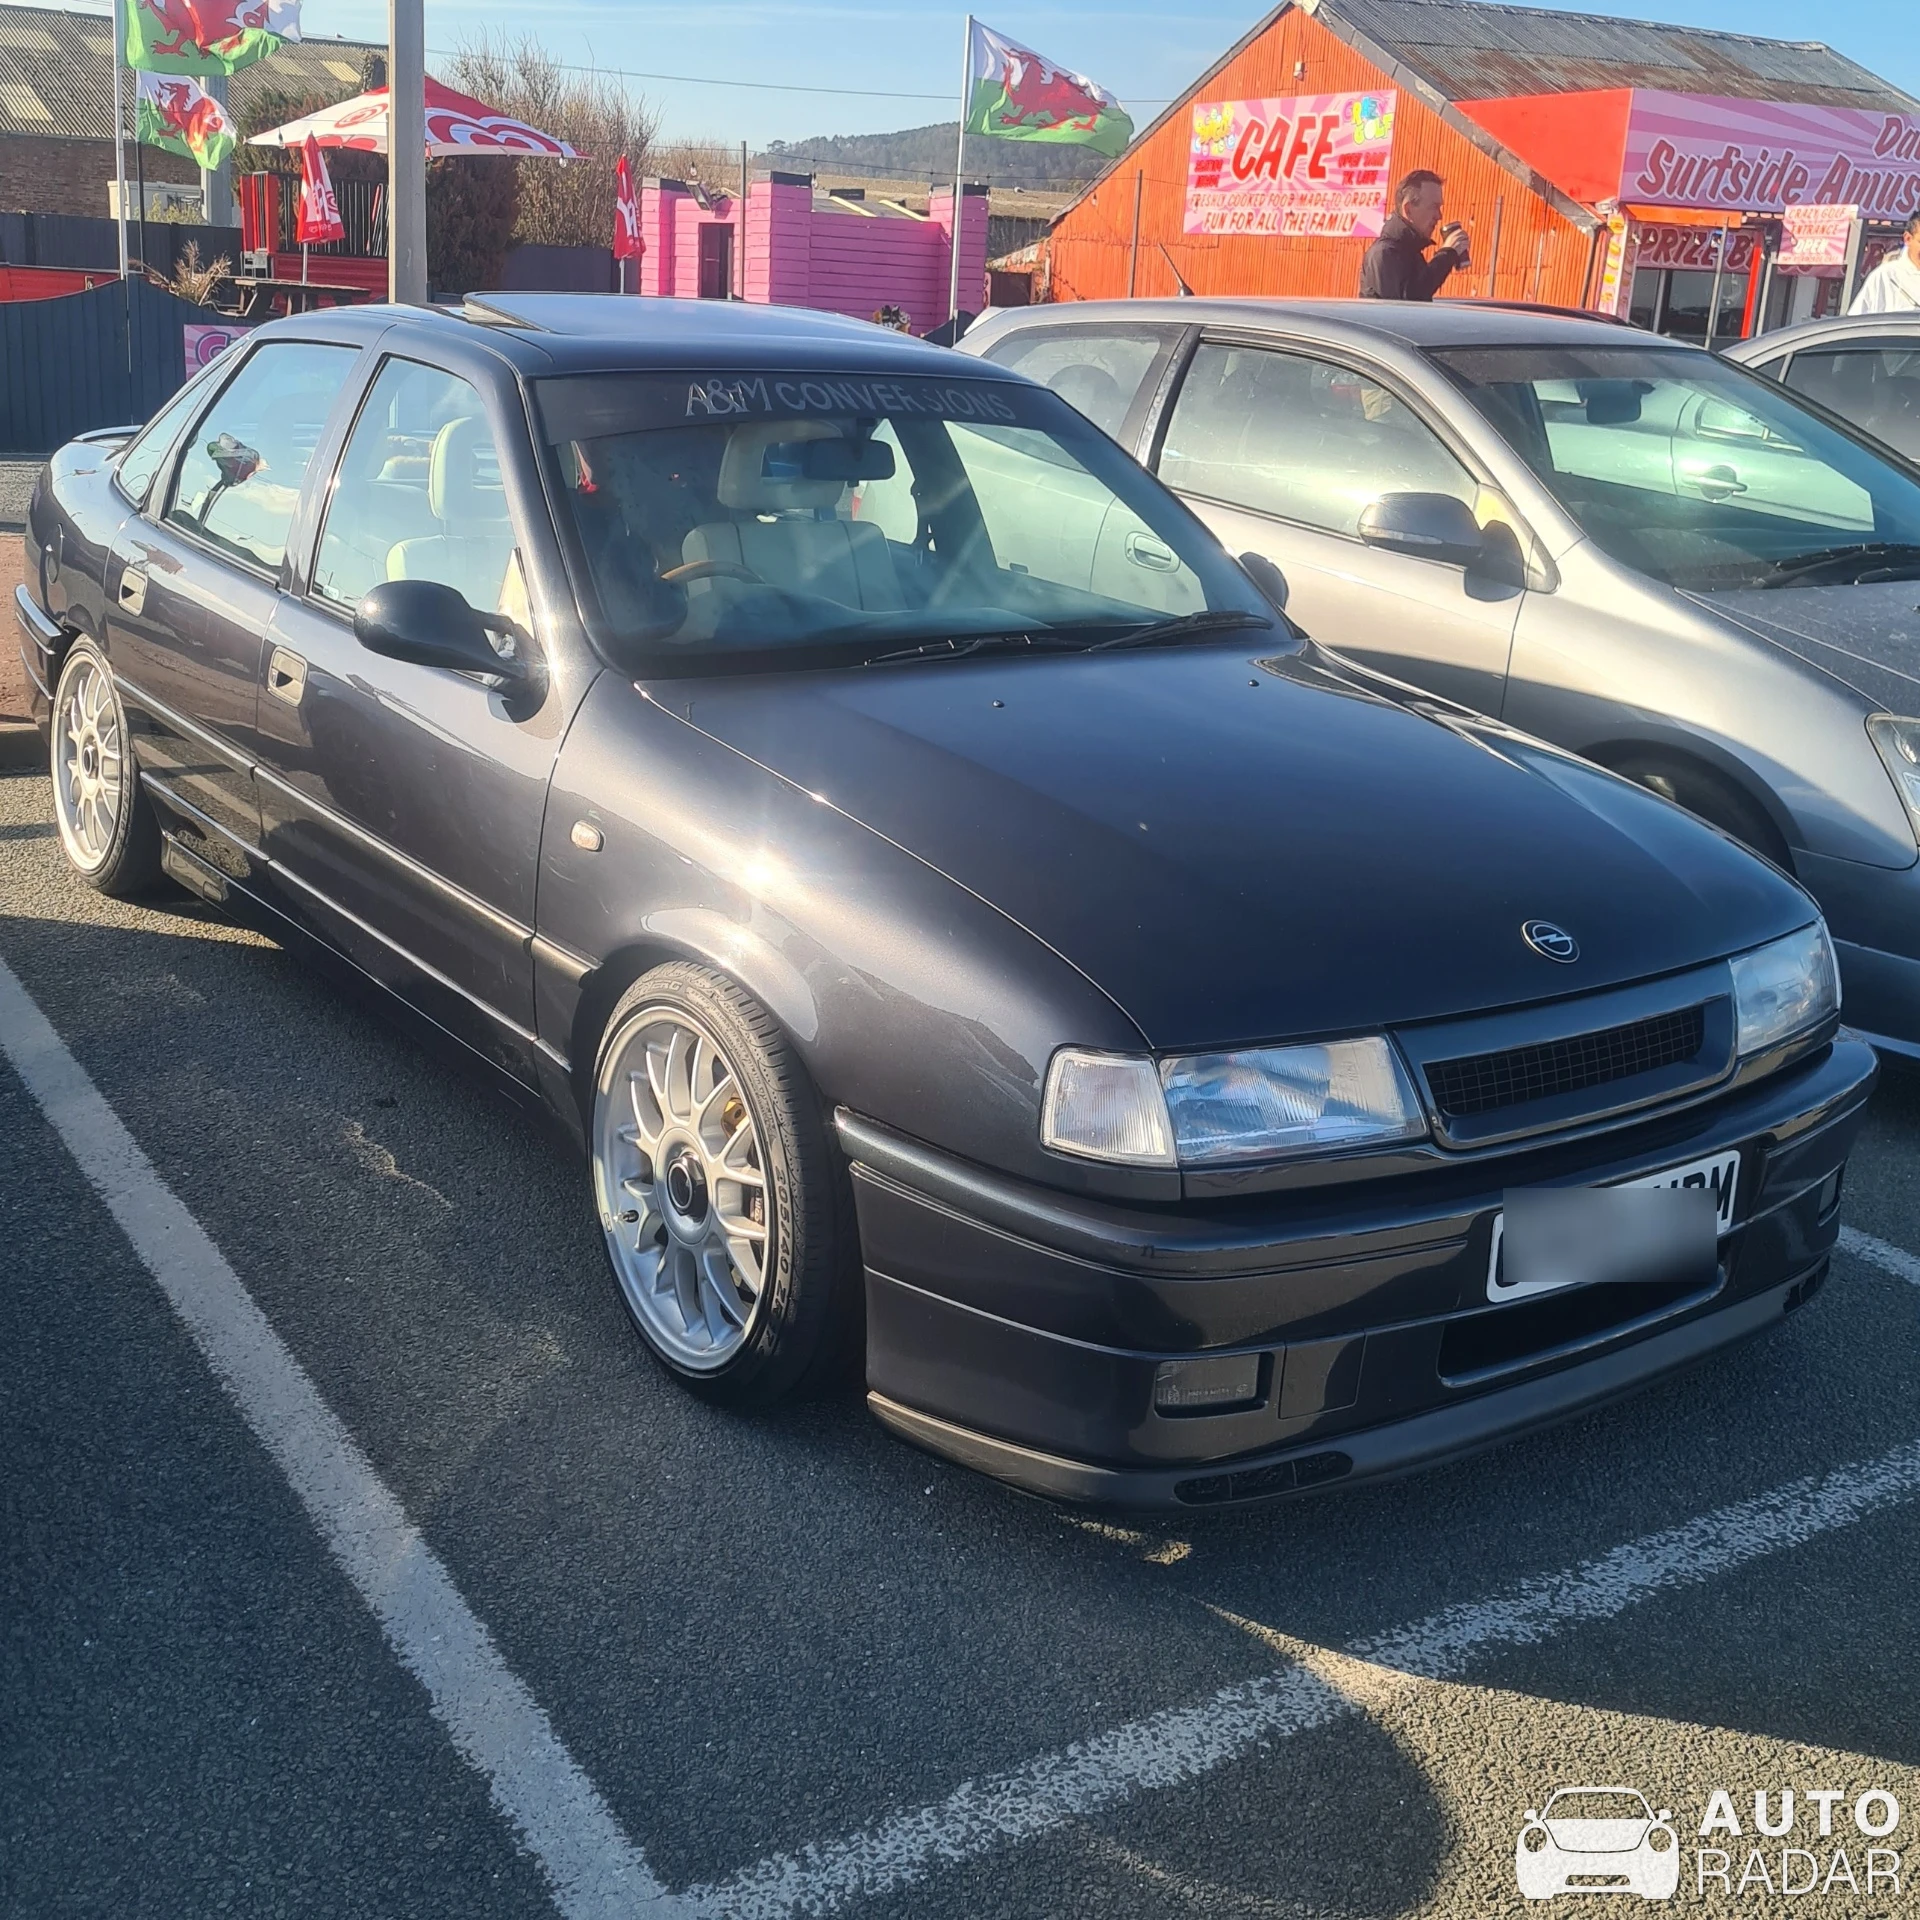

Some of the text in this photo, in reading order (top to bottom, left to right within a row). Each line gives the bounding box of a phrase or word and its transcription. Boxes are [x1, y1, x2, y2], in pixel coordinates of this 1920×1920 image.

[1232, 114, 1340, 180] CAFE
[1637, 139, 1920, 214] Surfside Amus
[1227, 193, 1266, 208] COOKED
[1267, 193, 1296, 207] FOOD
[1299, 192, 1327, 207] MADE
[1328, 193, 1342, 207] TO
[1344, 192, 1380, 207] ORDER
[1788, 206, 1847, 220] CRAZY GOLF
[1204, 212, 1358, 233] FUN FOR ALL THE FAMILY
[1791, 222, 1840, 236] ENTRANCE
[1639, 227, 1722, 266] PRIZE
[1794, 238, 1829, 254] OPEN
[685, 377, 773, 417] A&M
[775, 1165, 792, 1274] 205/40
